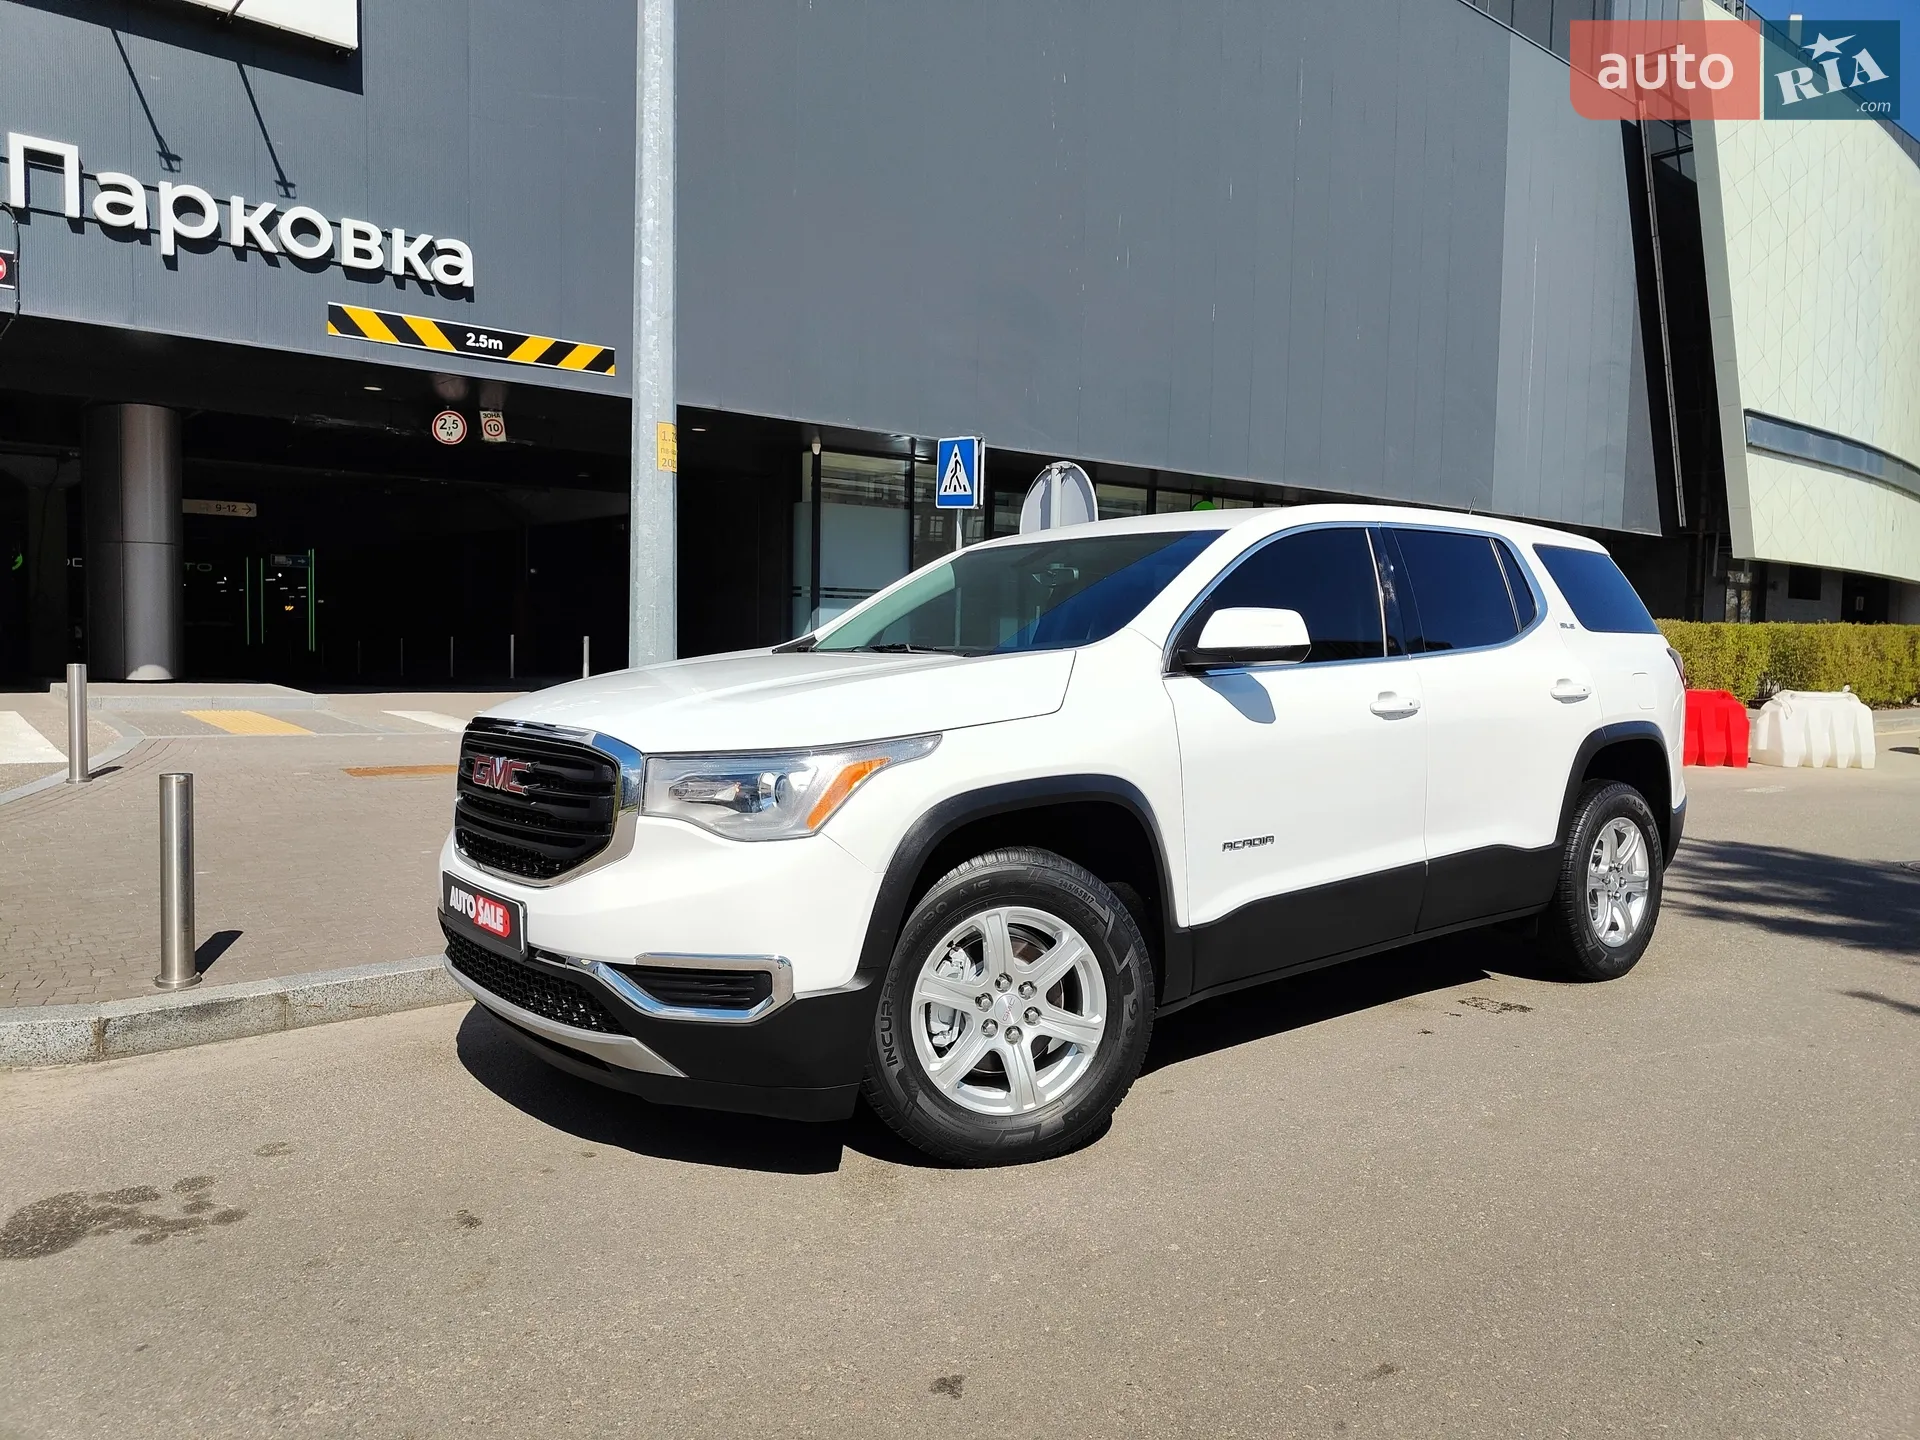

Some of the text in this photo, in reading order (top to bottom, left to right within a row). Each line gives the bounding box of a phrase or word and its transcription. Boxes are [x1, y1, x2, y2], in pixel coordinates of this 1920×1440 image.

[9, 131, 474, 287] Парковка
[465, 332, 504, 351] 2.5m
[439, 417, 459, 431] 2,5
[487, 423, 500, 432] 10
[215, 503, 237, 513] 9-12
[473, 755, 531, 796] GMC
[1221, 835, 1275, 852] ACADIA
[449, 885, 477, 919] AUTO
